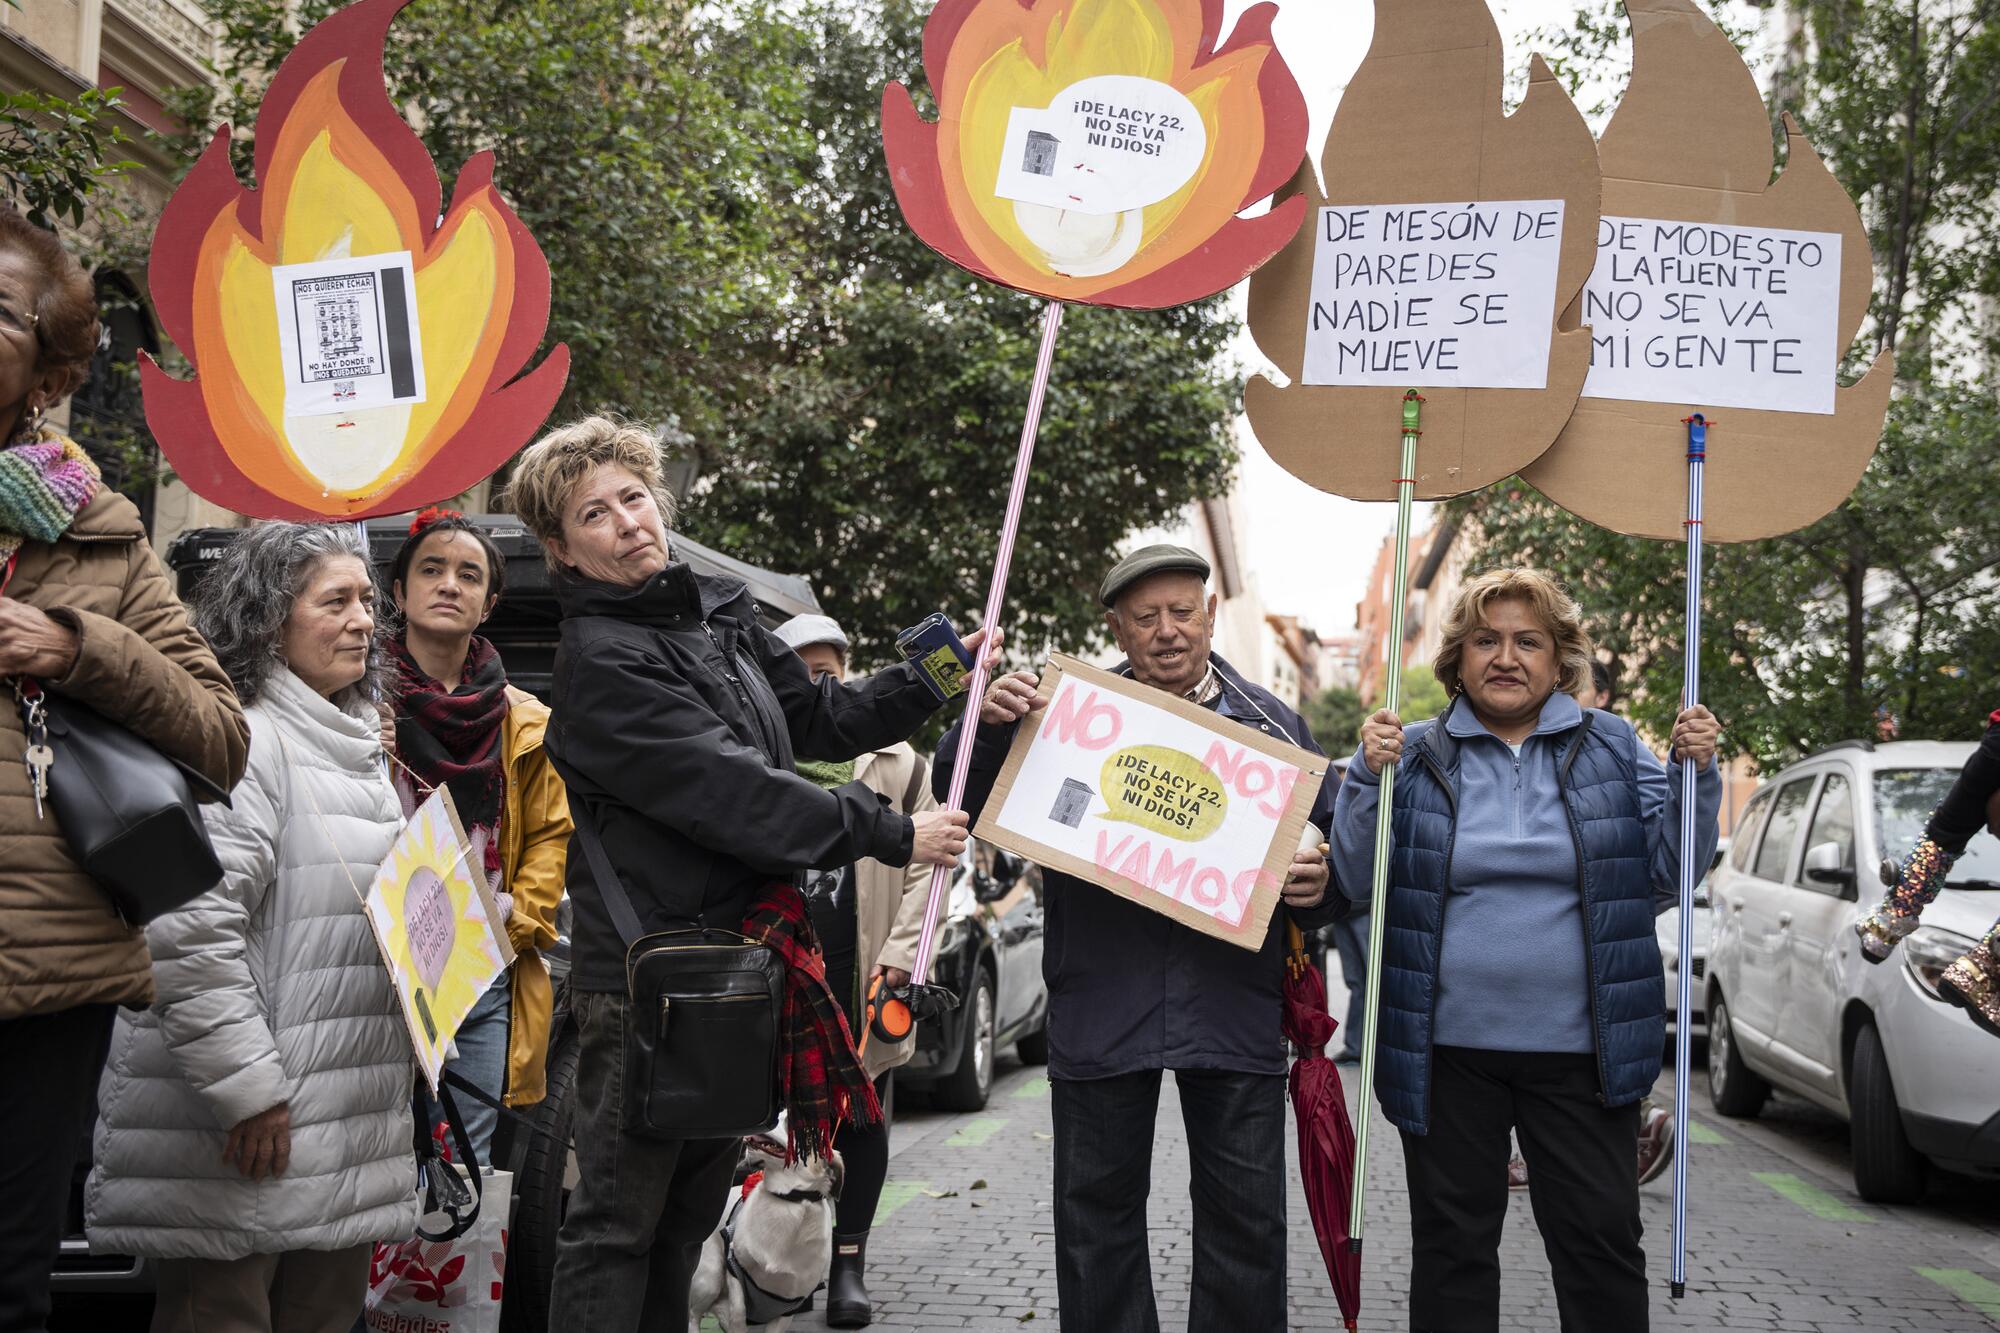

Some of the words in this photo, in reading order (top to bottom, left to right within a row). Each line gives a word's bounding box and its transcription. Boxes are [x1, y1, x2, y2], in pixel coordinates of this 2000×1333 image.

[1074, 100, 1105, 115] ¡DE
[1108, 105, 1155, 124] LACY
[1159, 115, 1184, 131] 22,
[1085, 117, 1112, 131] NO
[1115, 122, 1138, 136] SE
[1142, 127, 1165, 142] VA
[1087, 132, 1107, 146] NI
[1111, 137, 1161, 156] DIOS!
[1326, 210, 1369, 242] DE
[1383, 203, 1499, 242] MESÓN
[1513, 211, 1559, 242] DE
[1597, 219, 1642, 250] DE
[1654, 225, 1822, 267] MODESTO
[314, 280, 345, 292] QUIEREN
[1335, 252, 1498, 289] PAREDES
[1453, 294, 1508, 325] SE
[1587, 289, 1642, 321] NO
[1659, 293, 1706, 323] SE
[1719, 297, 1774, 329] VA
[309, 363, 319, 371] NO
[322, 361, 337, 369] HAY
[340, 357, 364, 367] DONDE
[367, 356, 375, 364] IR
[1338, 338, 1459, 375] MUEVE
[1644, 334, 1803, 374] GENTE
[1041, 682, 1123, 750] NO
[1116, 755, 1148, 774] ¡DE
[1150, 765, 1197, 793] LACY
[1197, 787, 1221, 808] 22,
[1124, 772, 1150, 791] NO
[1153, 785, 1176, 803] SE
[1180, 795, 1200, 816] VA
[1200, 739, 1308, 820] NOS
[1122, 789, 1143, 806] NI
[1144, 799, 1194, 830] DIOS!
[1094, 829, 1278, 934] VAMOS
[415, 892, 432, 925] LACY
[415, 931, 426, 954] NO
[424, 918, 434, 938] SE
[431, 904, 443, 923] VA
[423, 951, 432, 970] NI
[429, 923, 449, 958] DIOS!
